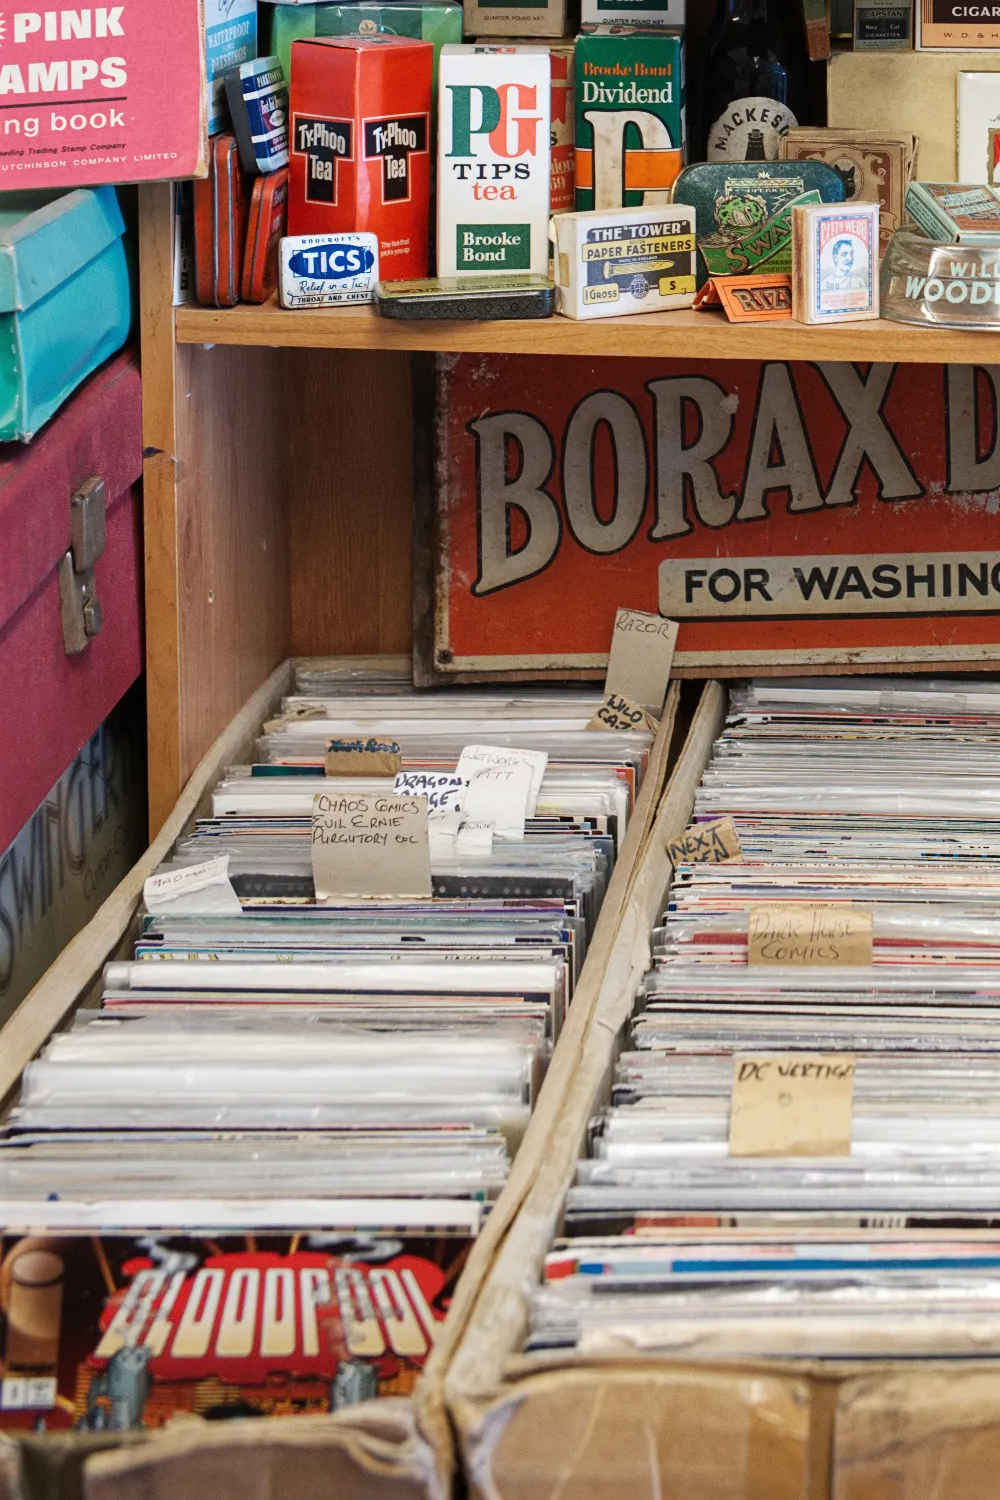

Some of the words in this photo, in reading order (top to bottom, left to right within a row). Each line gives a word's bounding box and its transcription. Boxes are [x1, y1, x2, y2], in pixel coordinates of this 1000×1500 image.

[14, 6, 125, 44] PINK
[582, 82, 673, 104] Dividend
[445, 83, 543, 159] PG
[73, 156, 127, 167] COMPANY
[134, 152, 178, 161] LIMITED
[453, 163, 531, 180] TIPS
[472, 181, 518, 201] tea
[463, 232, 521, 246] Brooke
[587, 245, 623, 260] PAPER
[626, 239, 692, 256] FASTENERS
[303, 249, 361, 273] TICS
[463, 248, 506, 262] Bond
[466, 360, 924, 598] BORAX
[684, 568, 773, 603] FOR
[615, 610, 672, 640] RAZOR
